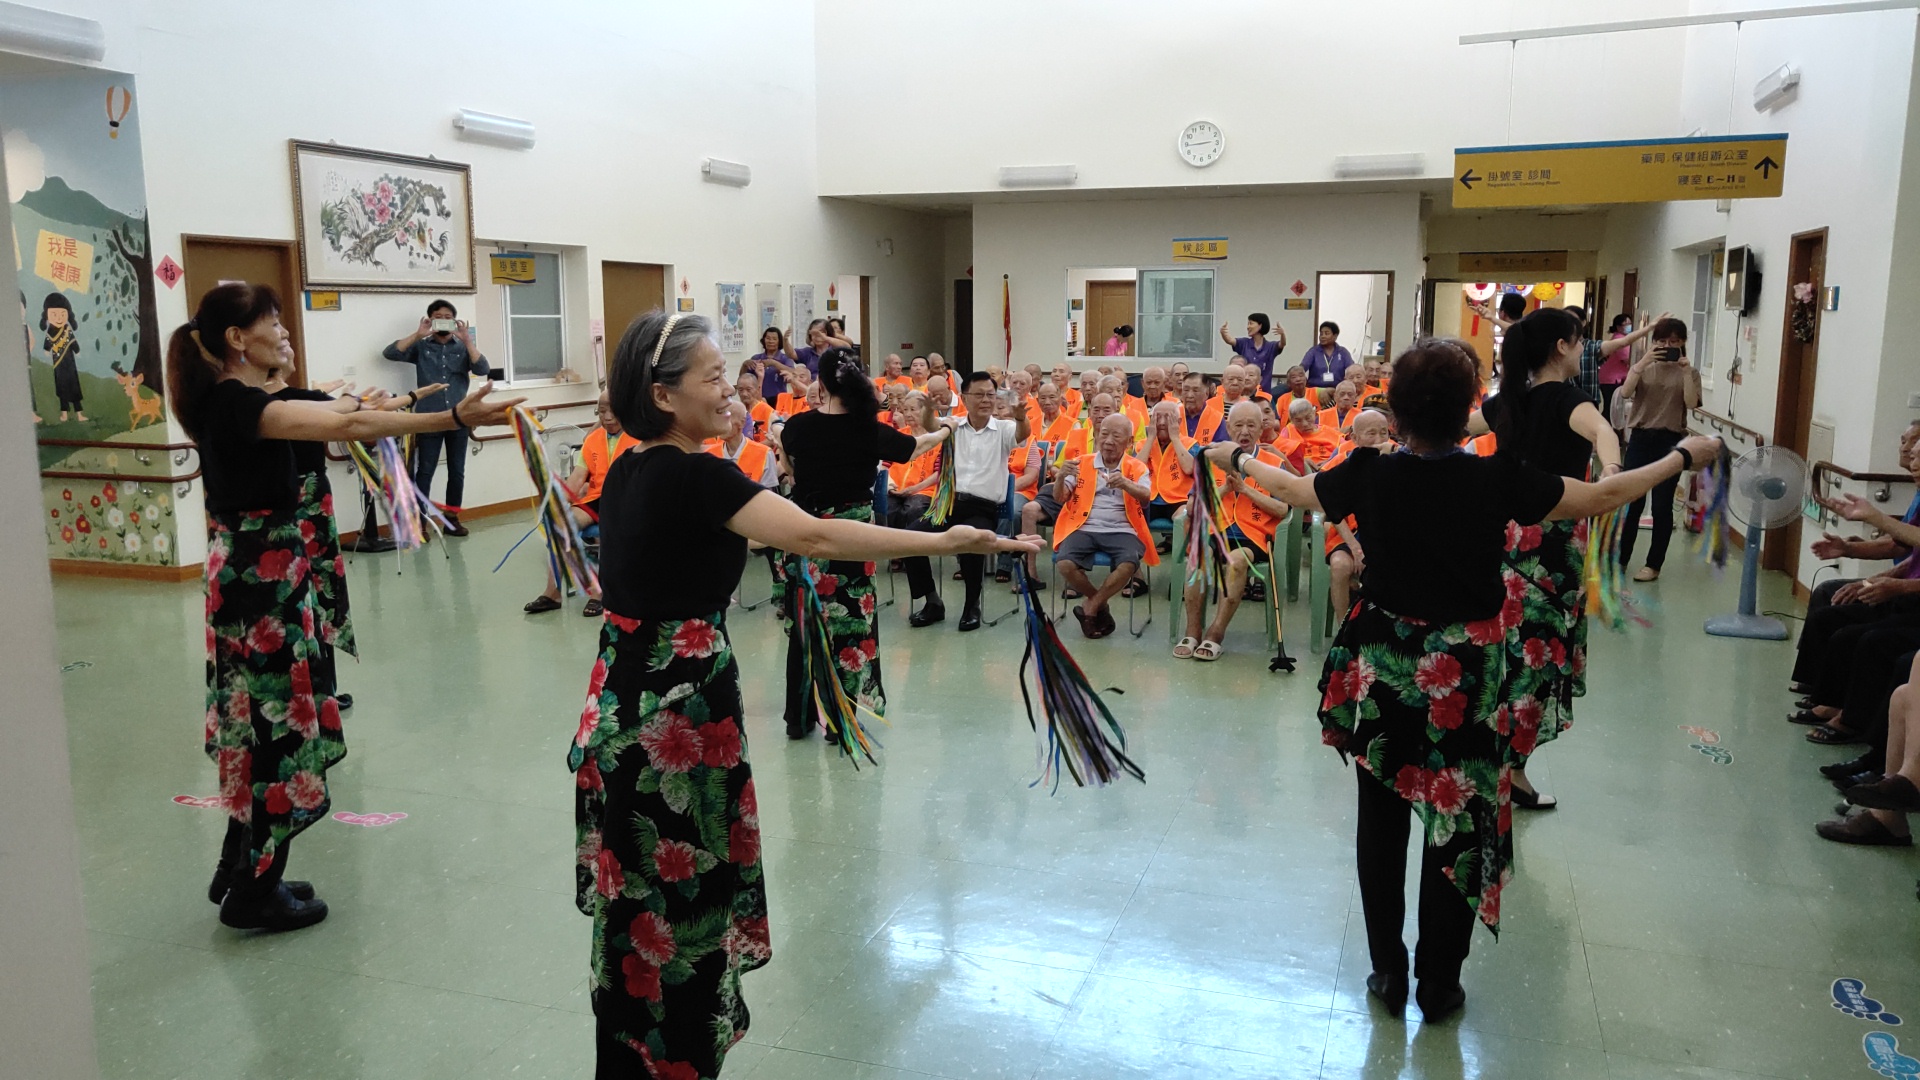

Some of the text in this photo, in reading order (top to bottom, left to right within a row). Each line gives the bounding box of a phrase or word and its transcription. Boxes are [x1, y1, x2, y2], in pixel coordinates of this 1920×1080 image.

[47, 237, 78, 259] 我是
[1182, 241, 1218, 253] 候診區
[50, 259, 82, 286] 健康
[162, 263, 177, 281] 福
